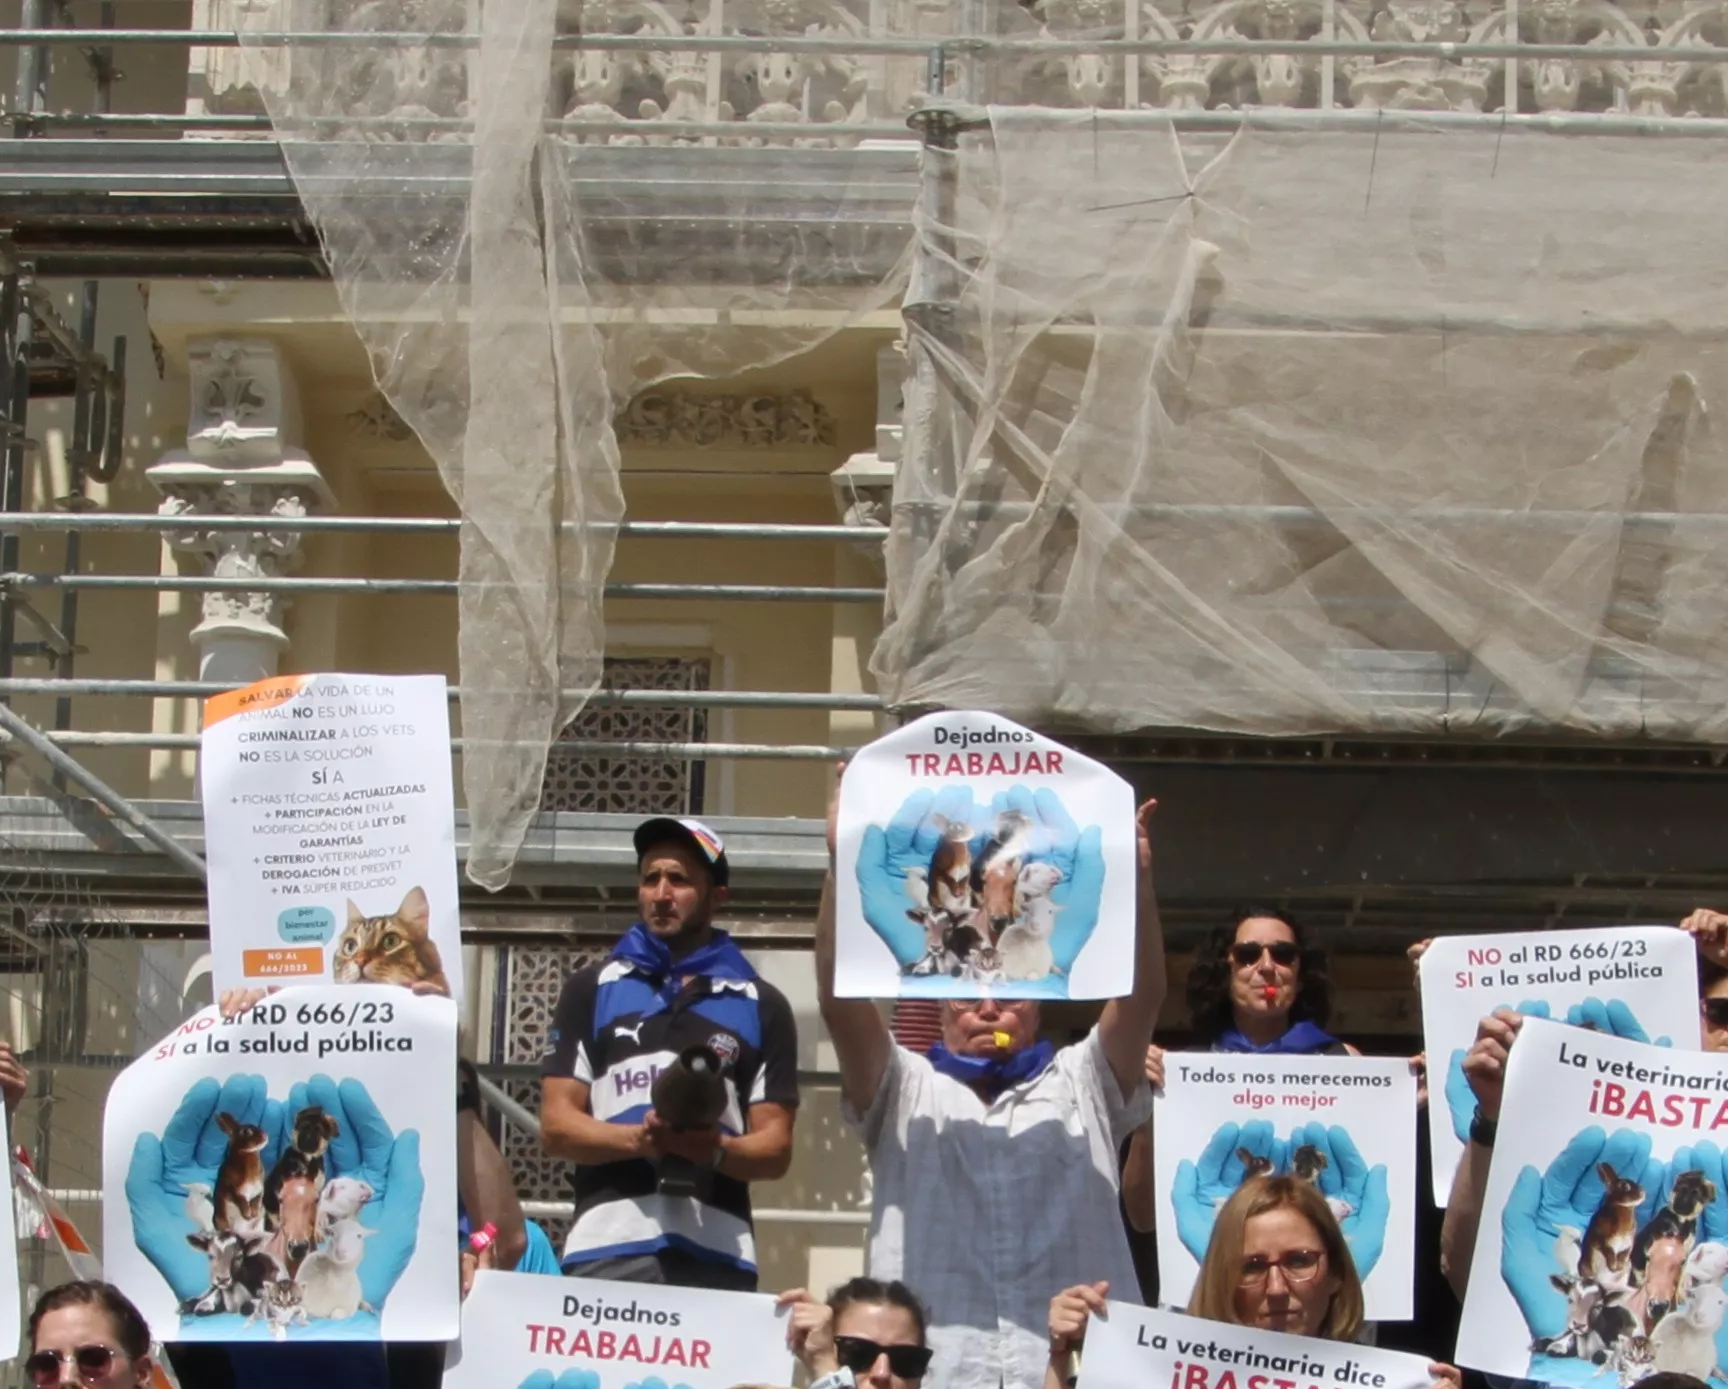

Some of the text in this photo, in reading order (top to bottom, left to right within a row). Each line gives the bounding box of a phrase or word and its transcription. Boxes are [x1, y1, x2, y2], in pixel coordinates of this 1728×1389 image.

[318, 686, 350, 697] VIDA
[293, 707, 313, 719] NO
[238, 729, 336, 744] CRIMINALIZAR
[934, 726, 1034, 749] Dejadnos
[239, 752, 260, 762] NO
[264, 751, 281, 762] ES
[906, 751, 1064, 776] TRABAJAR
[311, 768, 328, 785] SÍ
[343, 784, 426, 801] ACTUALIZADAS
[275, 803, 363, 819] PARTICIPACIÓN
[372, 817, 390, 829] LEY
[393, 815, 406, 826] DE
[300, 834, 363, 848] GARANTÍAS
[264, 853, 315, 864] CRITERIO
[262, 865, 340, 879] DEROGACIÓN
[281, 884, 301, 894] IVA
[1467, 940, 1647, 966] NO al RD 666/23
[1455, 963, 1663, 988] SI a la salud pública
[177, 1016, 214, 1036] NO
[252, 1004, 287, 1024] RD
[297, 1002, 394, 1026] 666/23
[154, 1031, 413, 1061] SI a la salud pública
[1558, 1043, 1587, 1069] La
[614, 1064, 667, 1097] Hel
[1180, 1066, 1391, 1087] Todos nos merecemos
[1233, 1089, 1337, 1111] algo mejor
[562, 1295, 681, 1326] Dejadnos
[526, 1324, 712, 1369] TRABAJAR
[1137, 1324, 1386, 1388] La veterinaria dice
